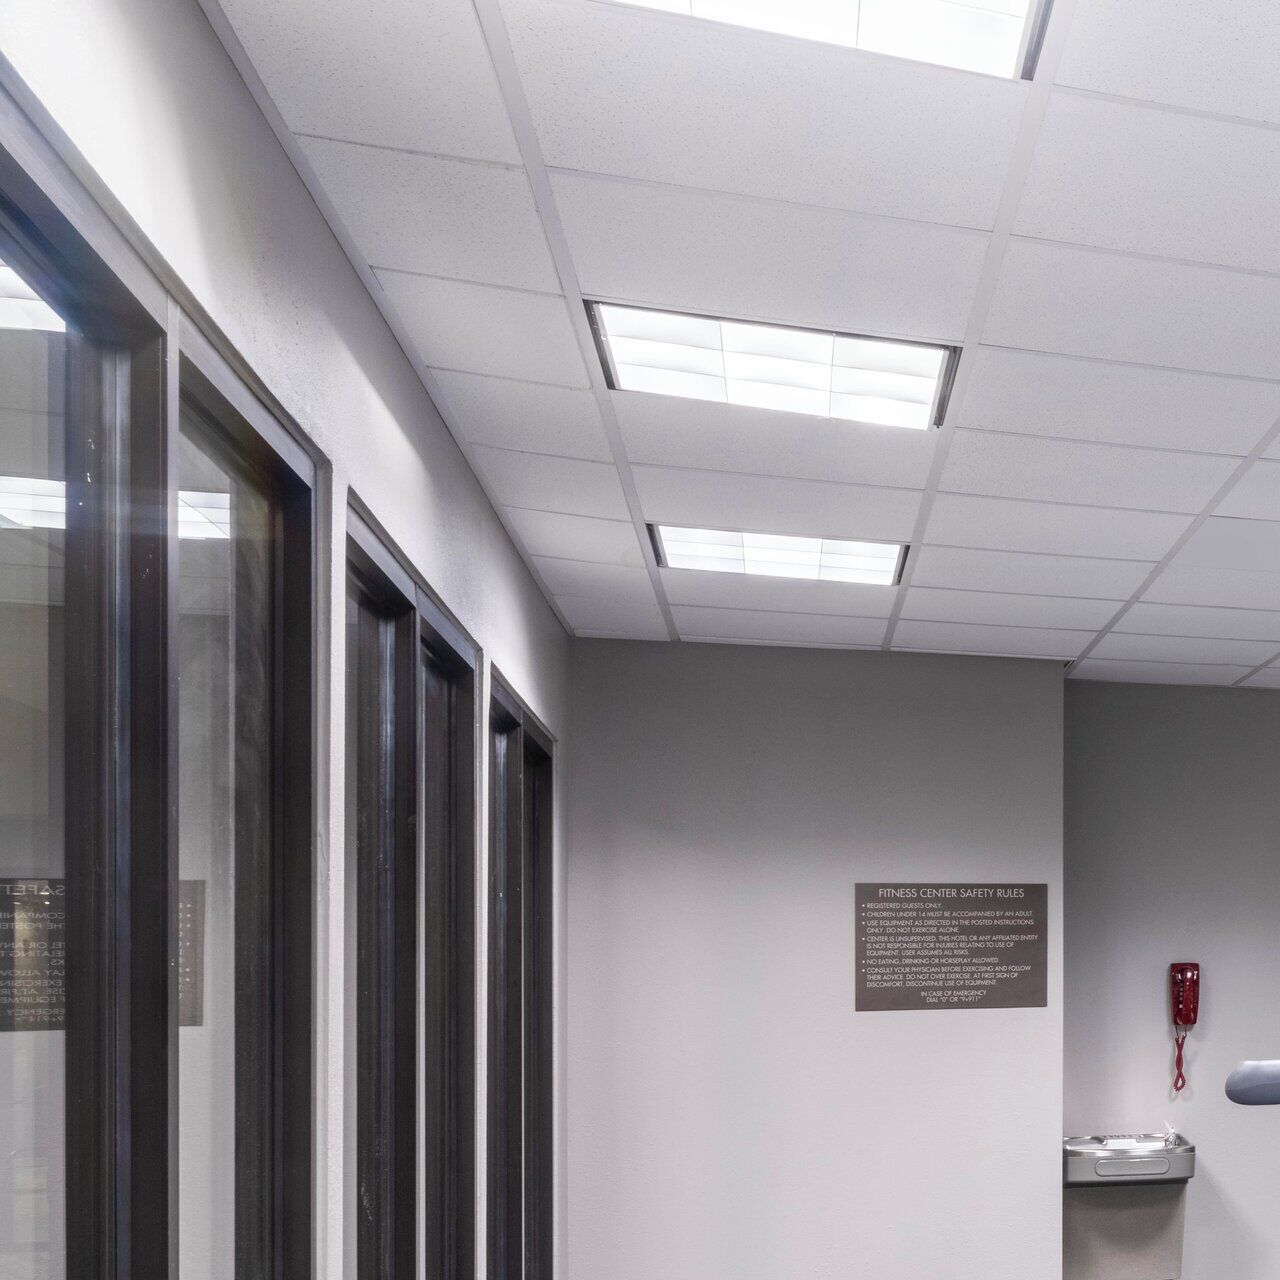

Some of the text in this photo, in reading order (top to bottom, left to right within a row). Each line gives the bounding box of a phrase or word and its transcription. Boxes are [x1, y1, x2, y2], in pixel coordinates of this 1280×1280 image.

[879, 888, 1024, 898] FITNESS CENTER SAFETY RULES
